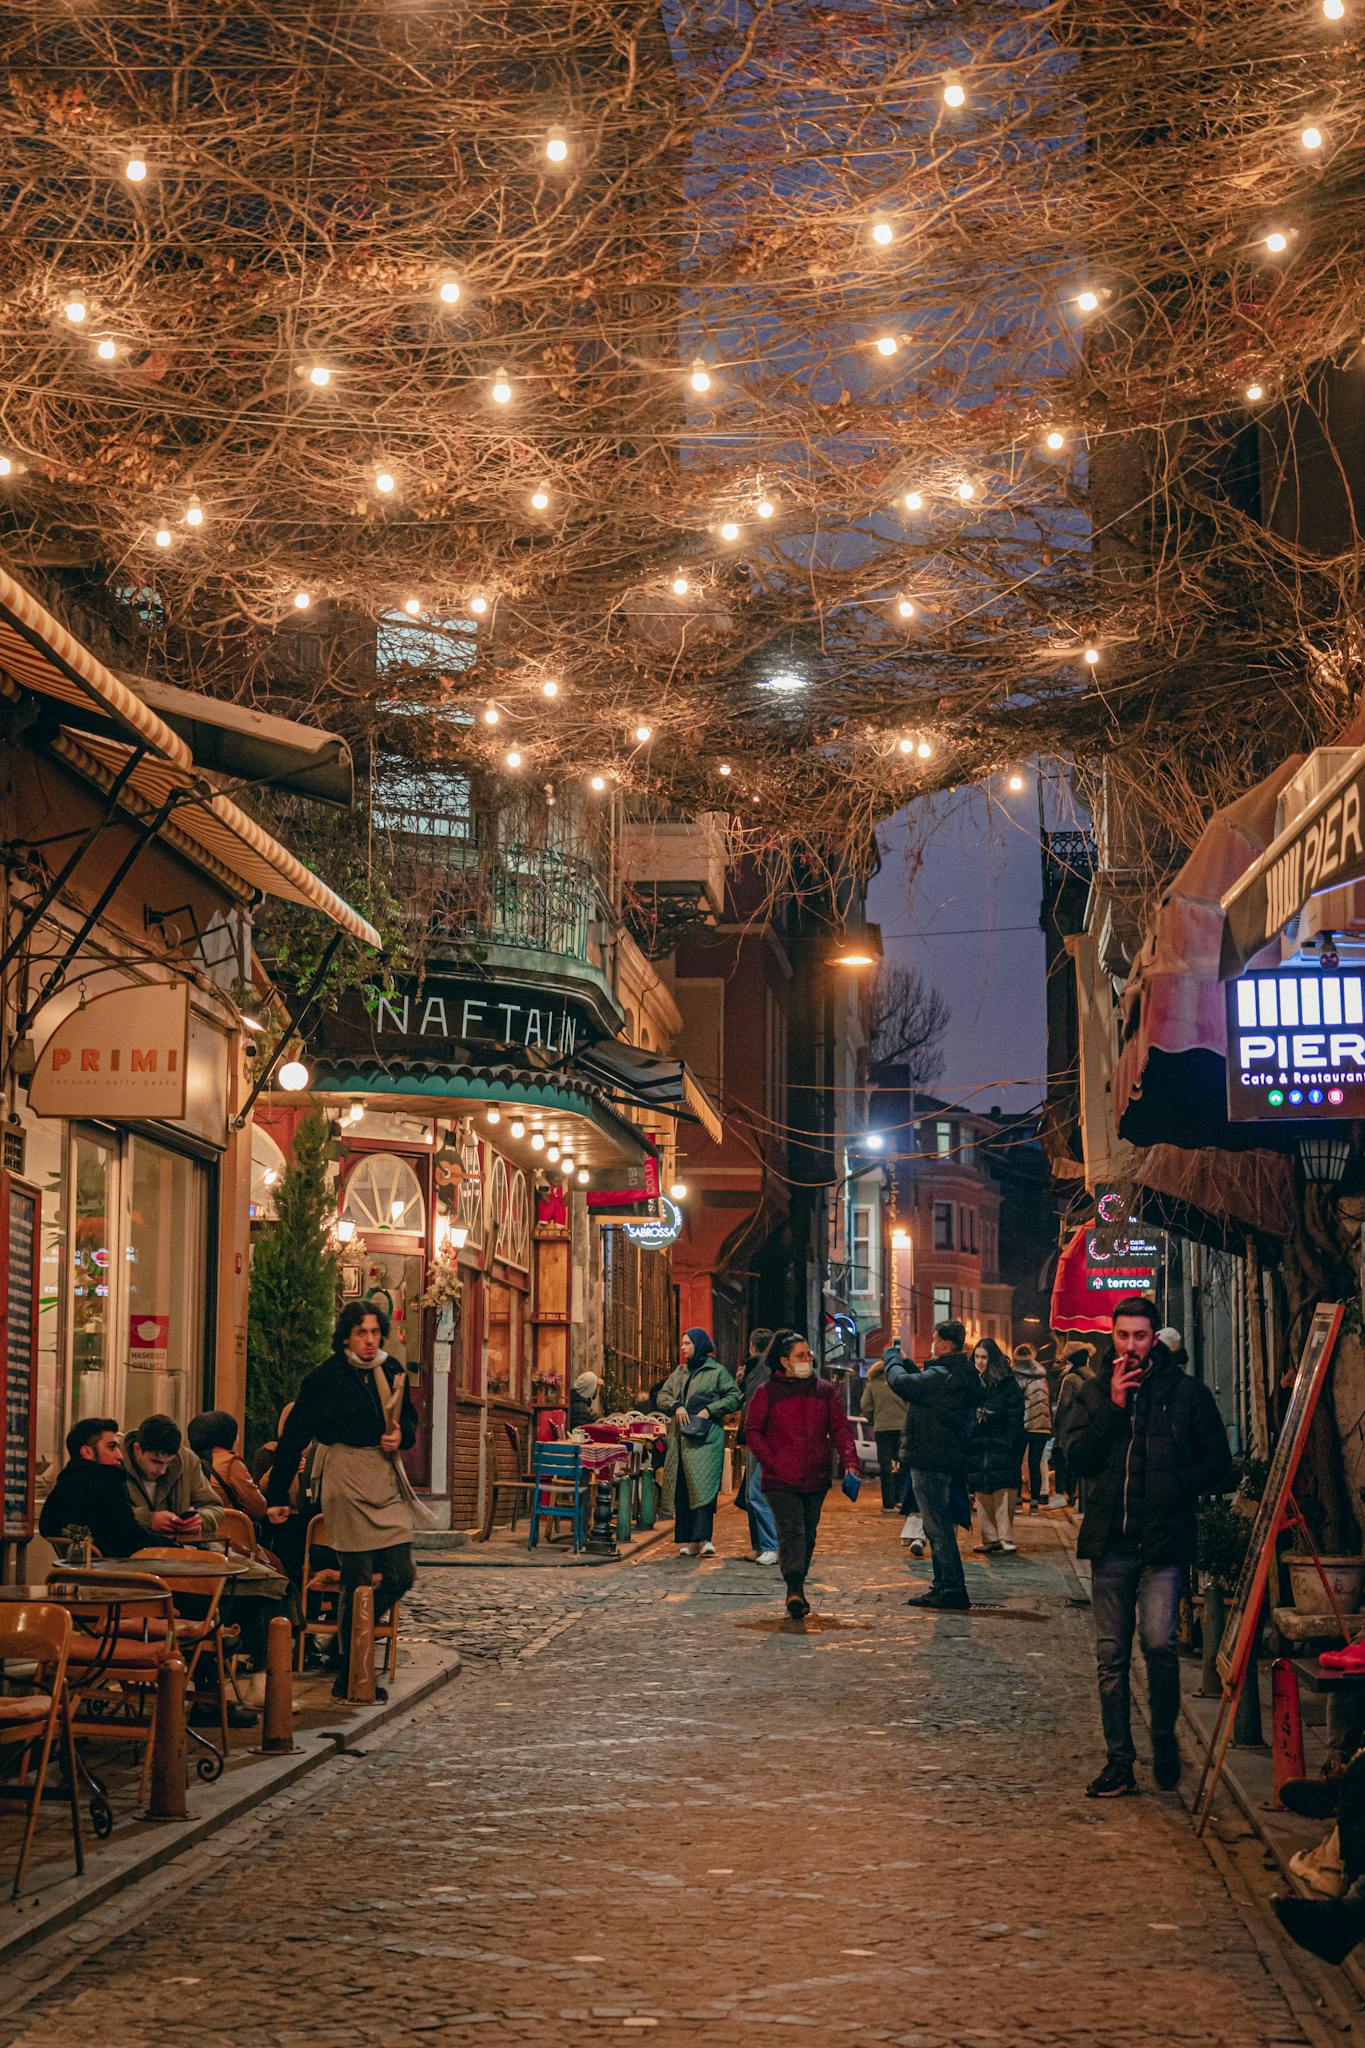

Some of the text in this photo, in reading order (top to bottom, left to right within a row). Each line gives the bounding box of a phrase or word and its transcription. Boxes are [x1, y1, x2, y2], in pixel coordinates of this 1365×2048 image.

[1302, 782, 1364, 901] PIER
[376, 995, 577, 1056] NAFTALIN
[52, 1048, 177, 1072] PRIMI
[1239, 1033, 1365, 1069] PIER
[1241, 1073, 1274, 1085] Cafe
[1279, 1072, 1288, 1085] &
[644, 1164, 656, 1194] COLD
[629, 1227, 677, 1238] SABROSSA
[1107, 1277, 1151, 1289] terrace
